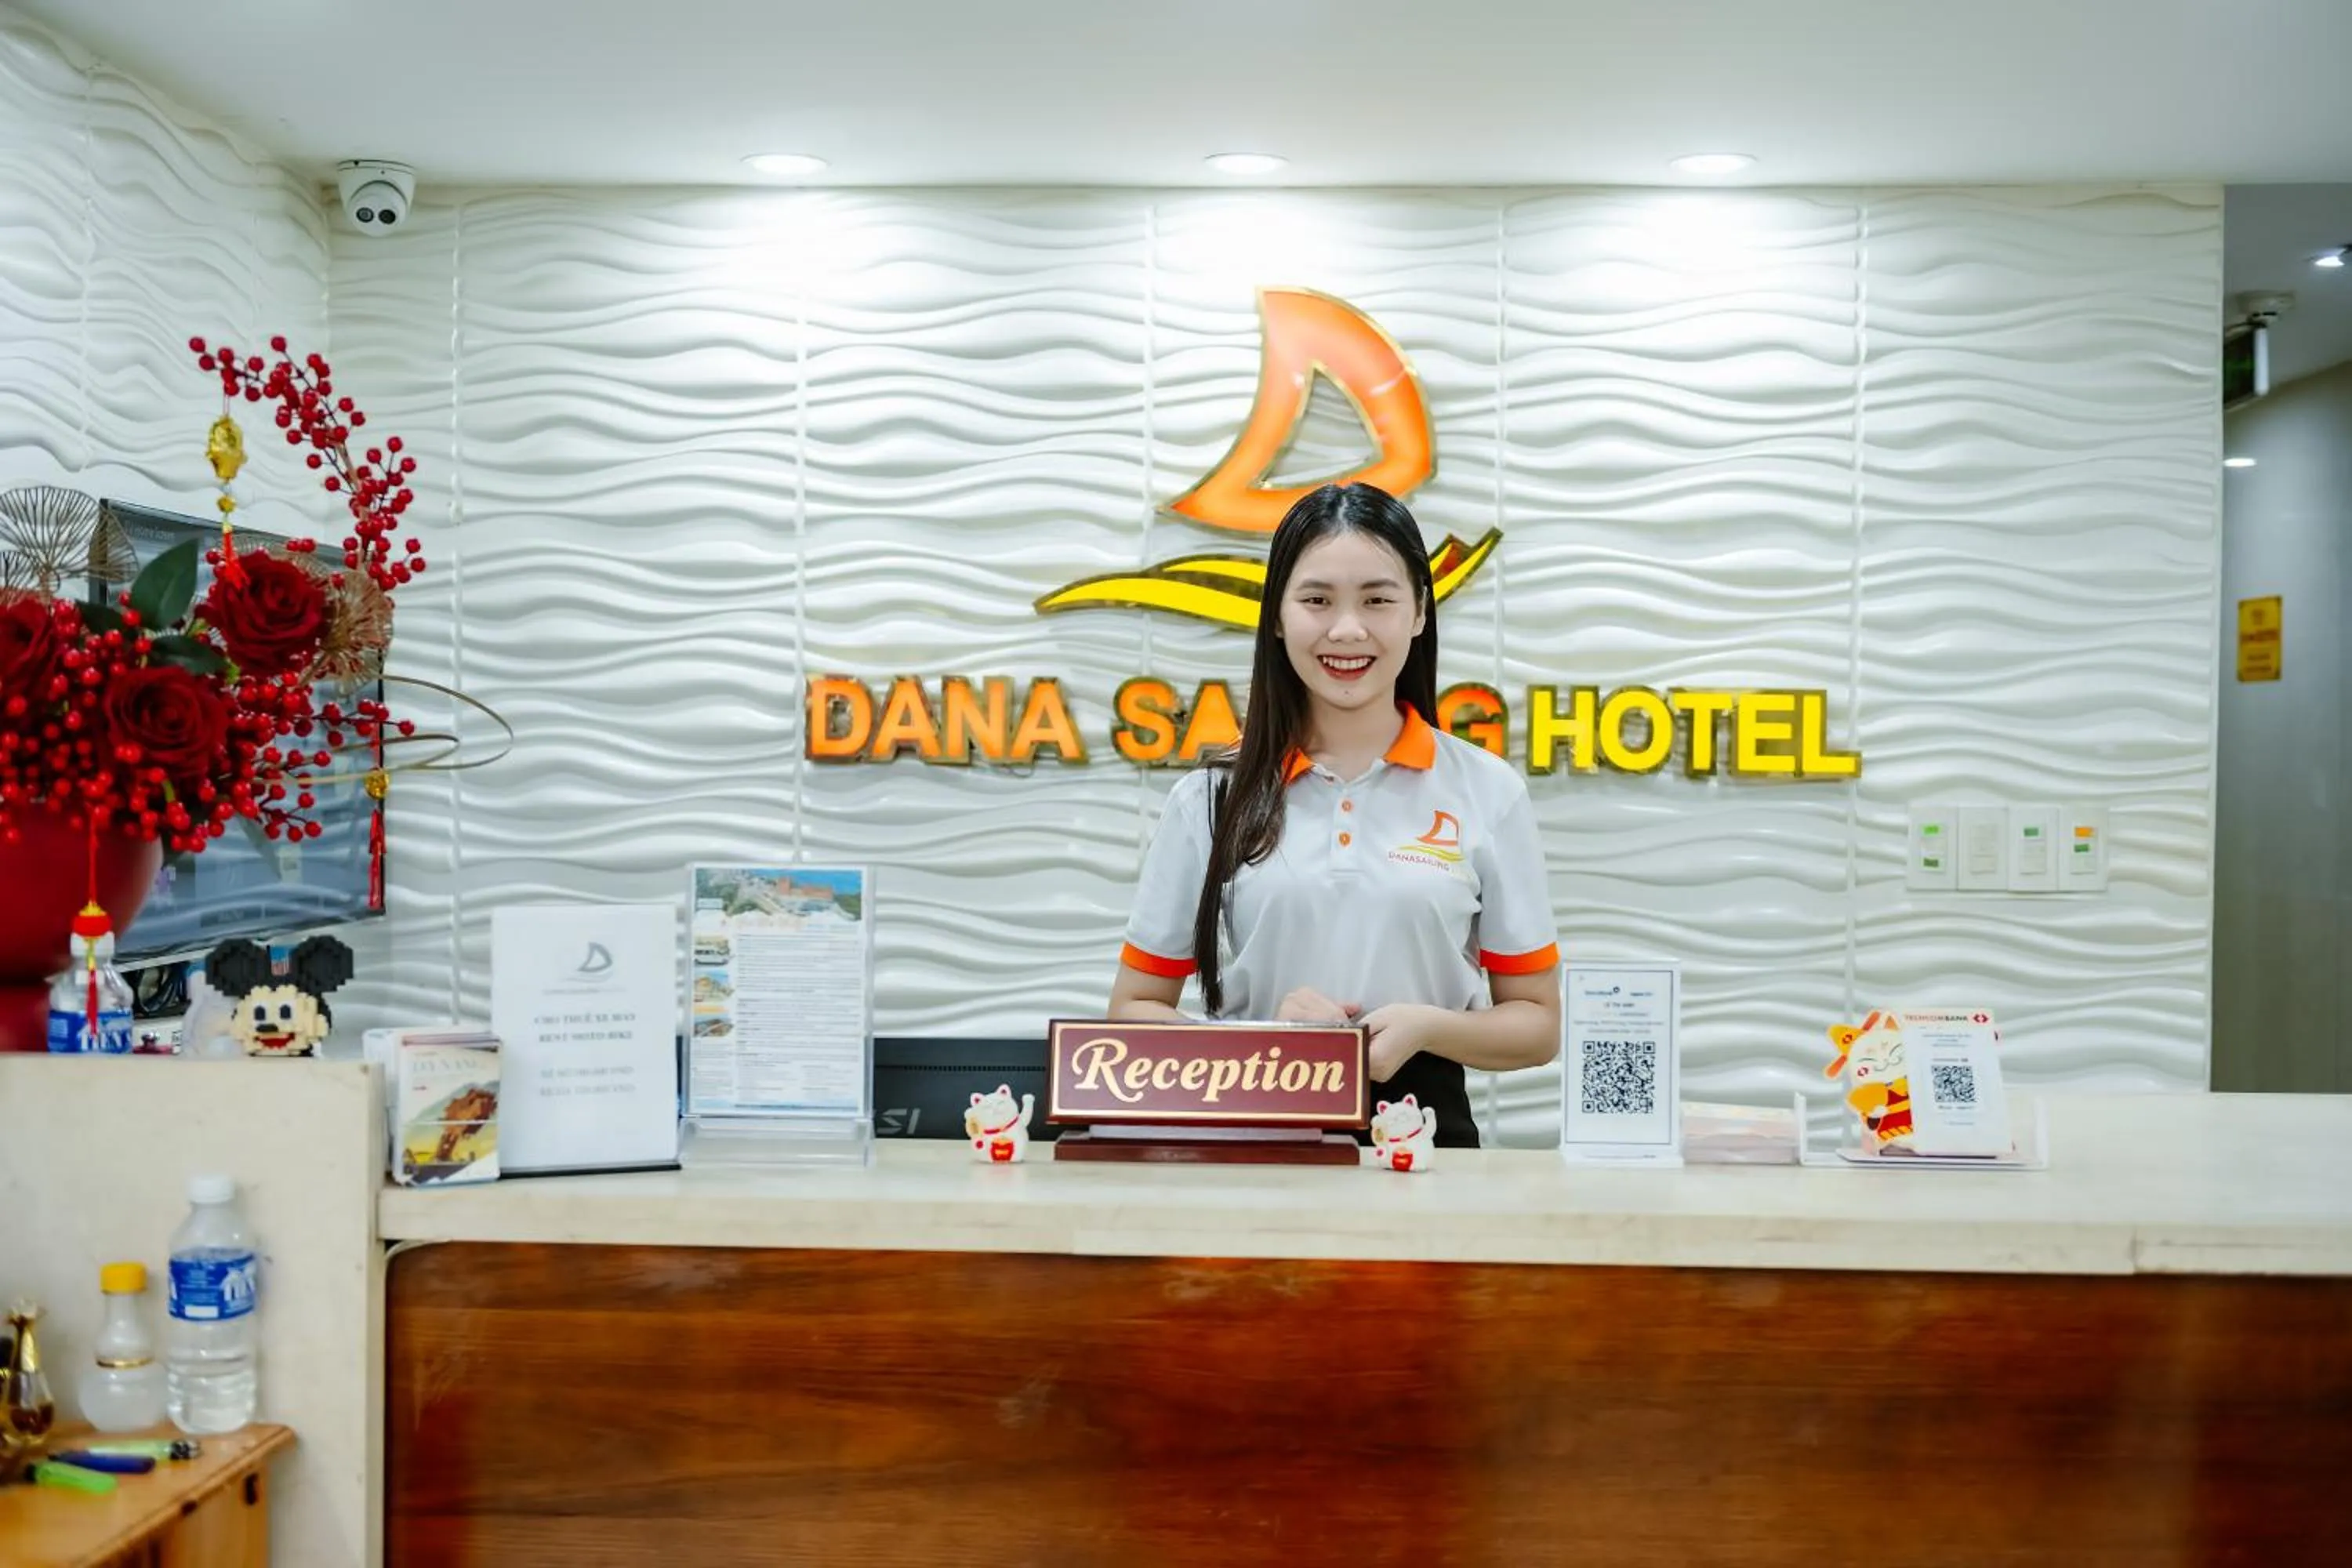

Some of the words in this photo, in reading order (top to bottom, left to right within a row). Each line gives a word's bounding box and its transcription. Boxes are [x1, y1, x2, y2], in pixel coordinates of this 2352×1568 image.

[805, 674, 1089, 765] DANA
[1526, 684, 1862, 779] HOTEL
[1071, 1037, 1345, 1103] Reception
[873, 1109, 921, 1135] SI
